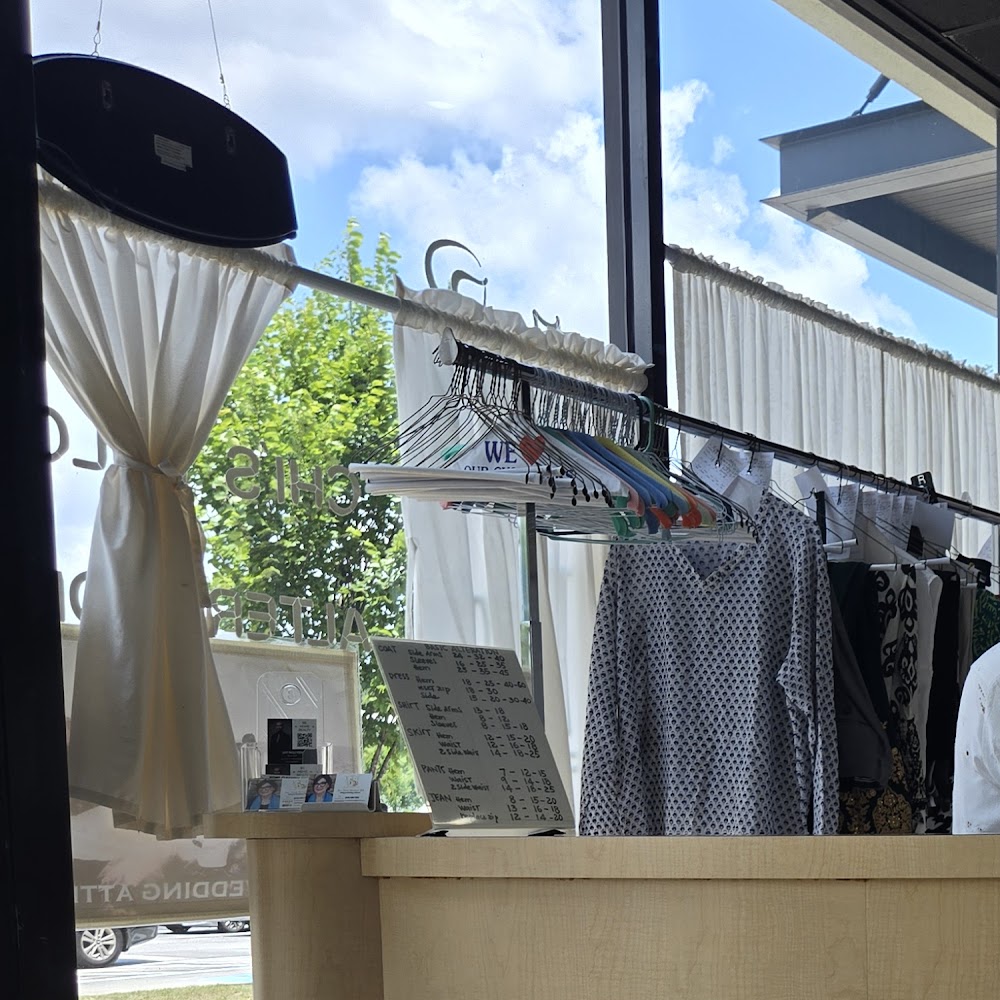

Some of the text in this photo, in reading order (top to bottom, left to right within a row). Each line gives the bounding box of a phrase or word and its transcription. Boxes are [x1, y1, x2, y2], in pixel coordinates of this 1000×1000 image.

[485, 440, 517, 463] WE
[378, 645, 396, 653] COAT
[424, 644, 499, 655] BASIC ALTERATION
[421, 764, 445, 774] PANTS
[499, 768, 505, 776] 7
[428, 793, 452, 802] JEAN
[509, 796, 516, 804] 8
[510, 813, 521, 821] 12
